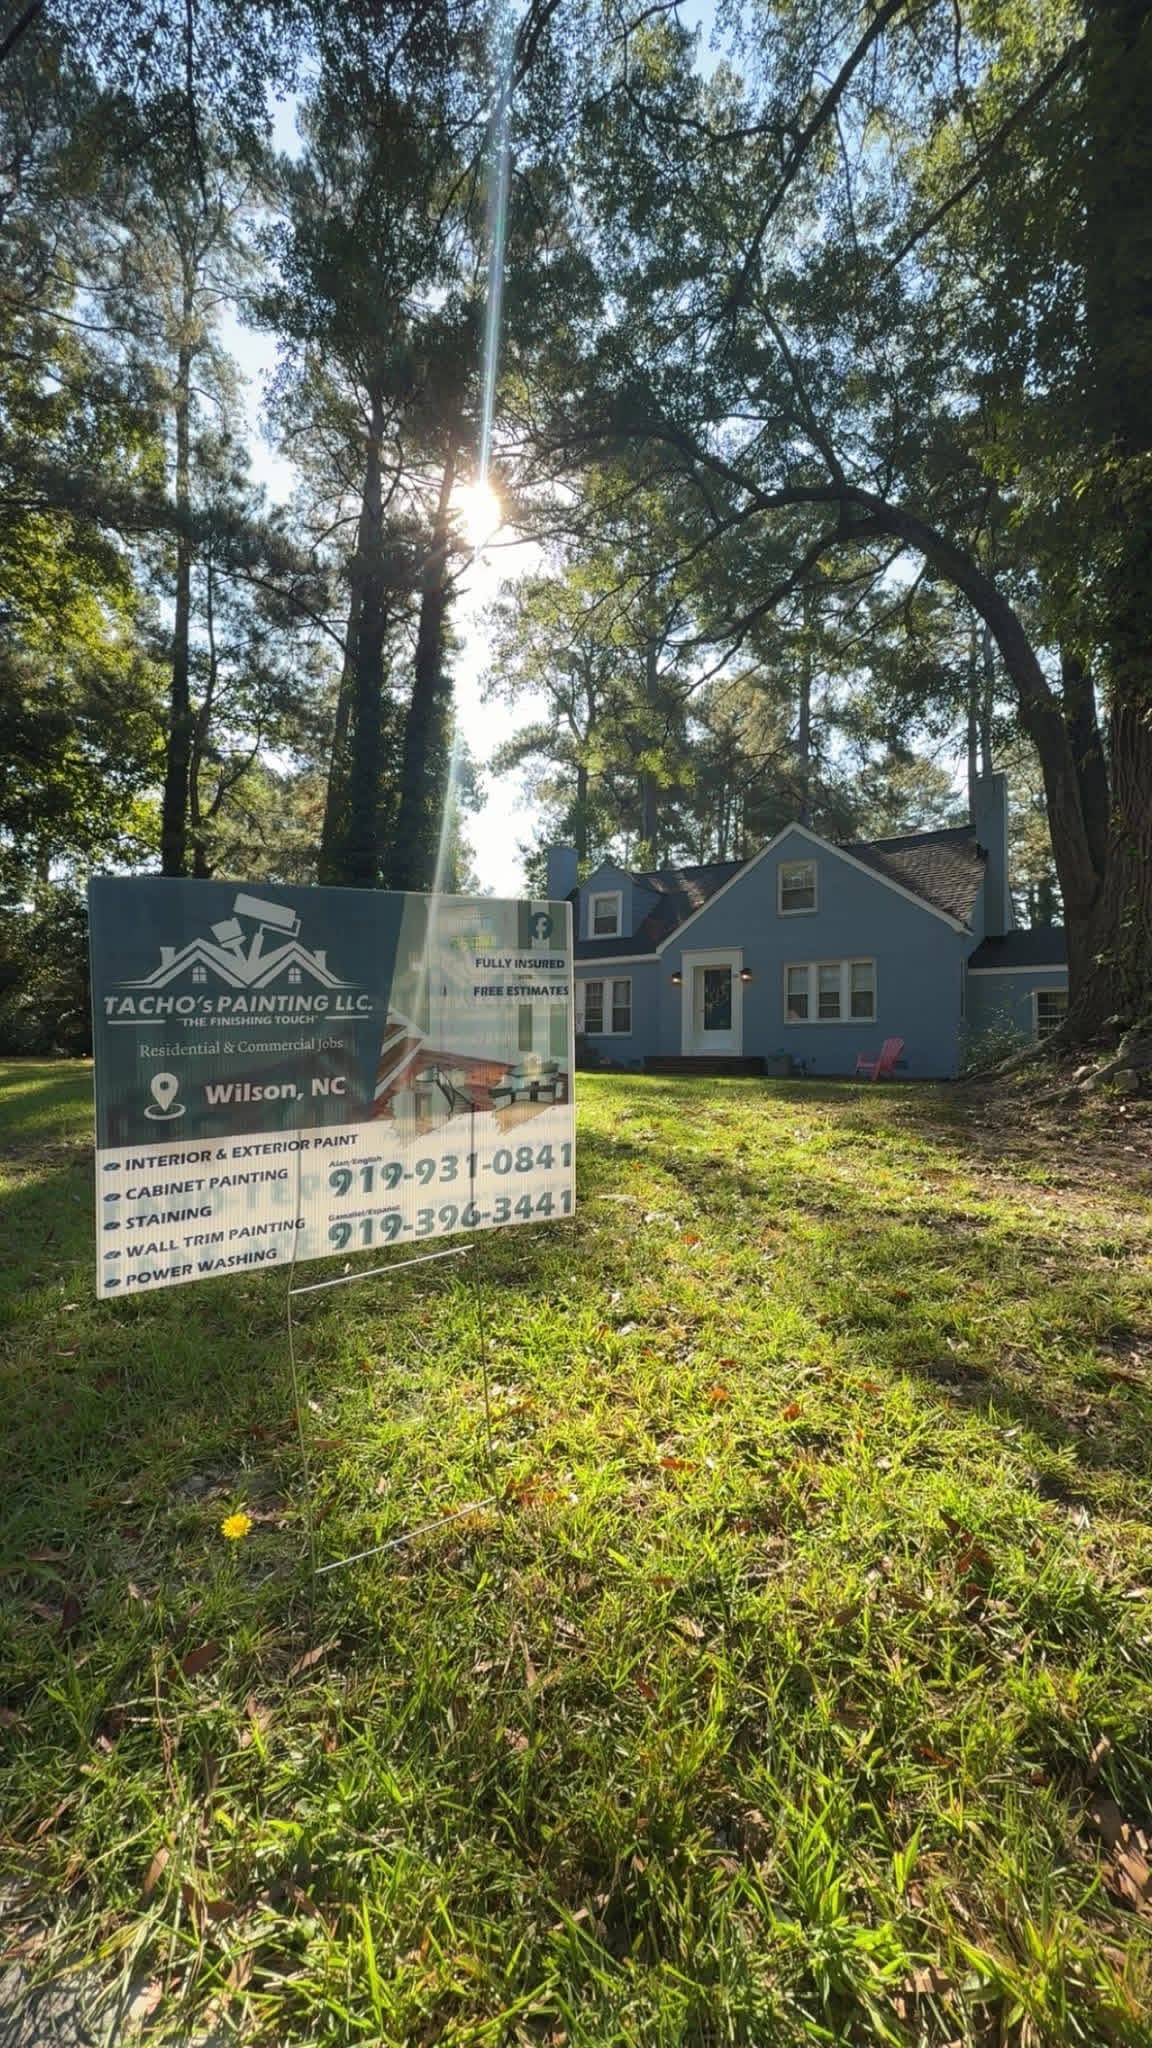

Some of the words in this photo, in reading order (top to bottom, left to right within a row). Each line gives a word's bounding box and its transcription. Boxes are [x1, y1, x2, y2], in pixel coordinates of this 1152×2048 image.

[475, 958, 512, 969] FULLY
[514, 959, 565, 969] INSURED
[217, 995, 329, 1013] PAINTING
[335, 994, 374, 1011] LLC.
[474, 986, 504, 997] FREE
[506, 986, 569, 997] ESTIMATES
[210, 1016, 272, 1027] FINISHING
[139, 1042, 220, 1059] Residential
[223, 1041, 235, 1054] &
[238, 1037, 316, 1053] Commercial
[317, 1036, 345, 1053] Jobs
[204, 1083, 305, 1106] Wilson,
[311, 1076, 347, 1097] NC
[125, 1150, 212, 1171] INTERIOR
[215, 1149, 227, 1161] &
[231, 1139, 310, 1158] EXTERIOR
[313, 1134, 359, 1149] PAINT
[125, 1179, 205, 1201] CABINET
[208, 1168, 289, 1188] PAINTING
[328, 1142, 572, 1197] 919-931-0841
[125, 1205, 212, 1229] STAINING
[327, 1189, 572, 1250] 919-396-3441
[126, 1239, 179, 1258] WALL
[183, 1231, 225, 1247] TRIM
[228, 1217, 306, 1240] PAINTING
[126, 1263, 193, 1286] POWER
[197, 1248, 278, 1272] WASHING
